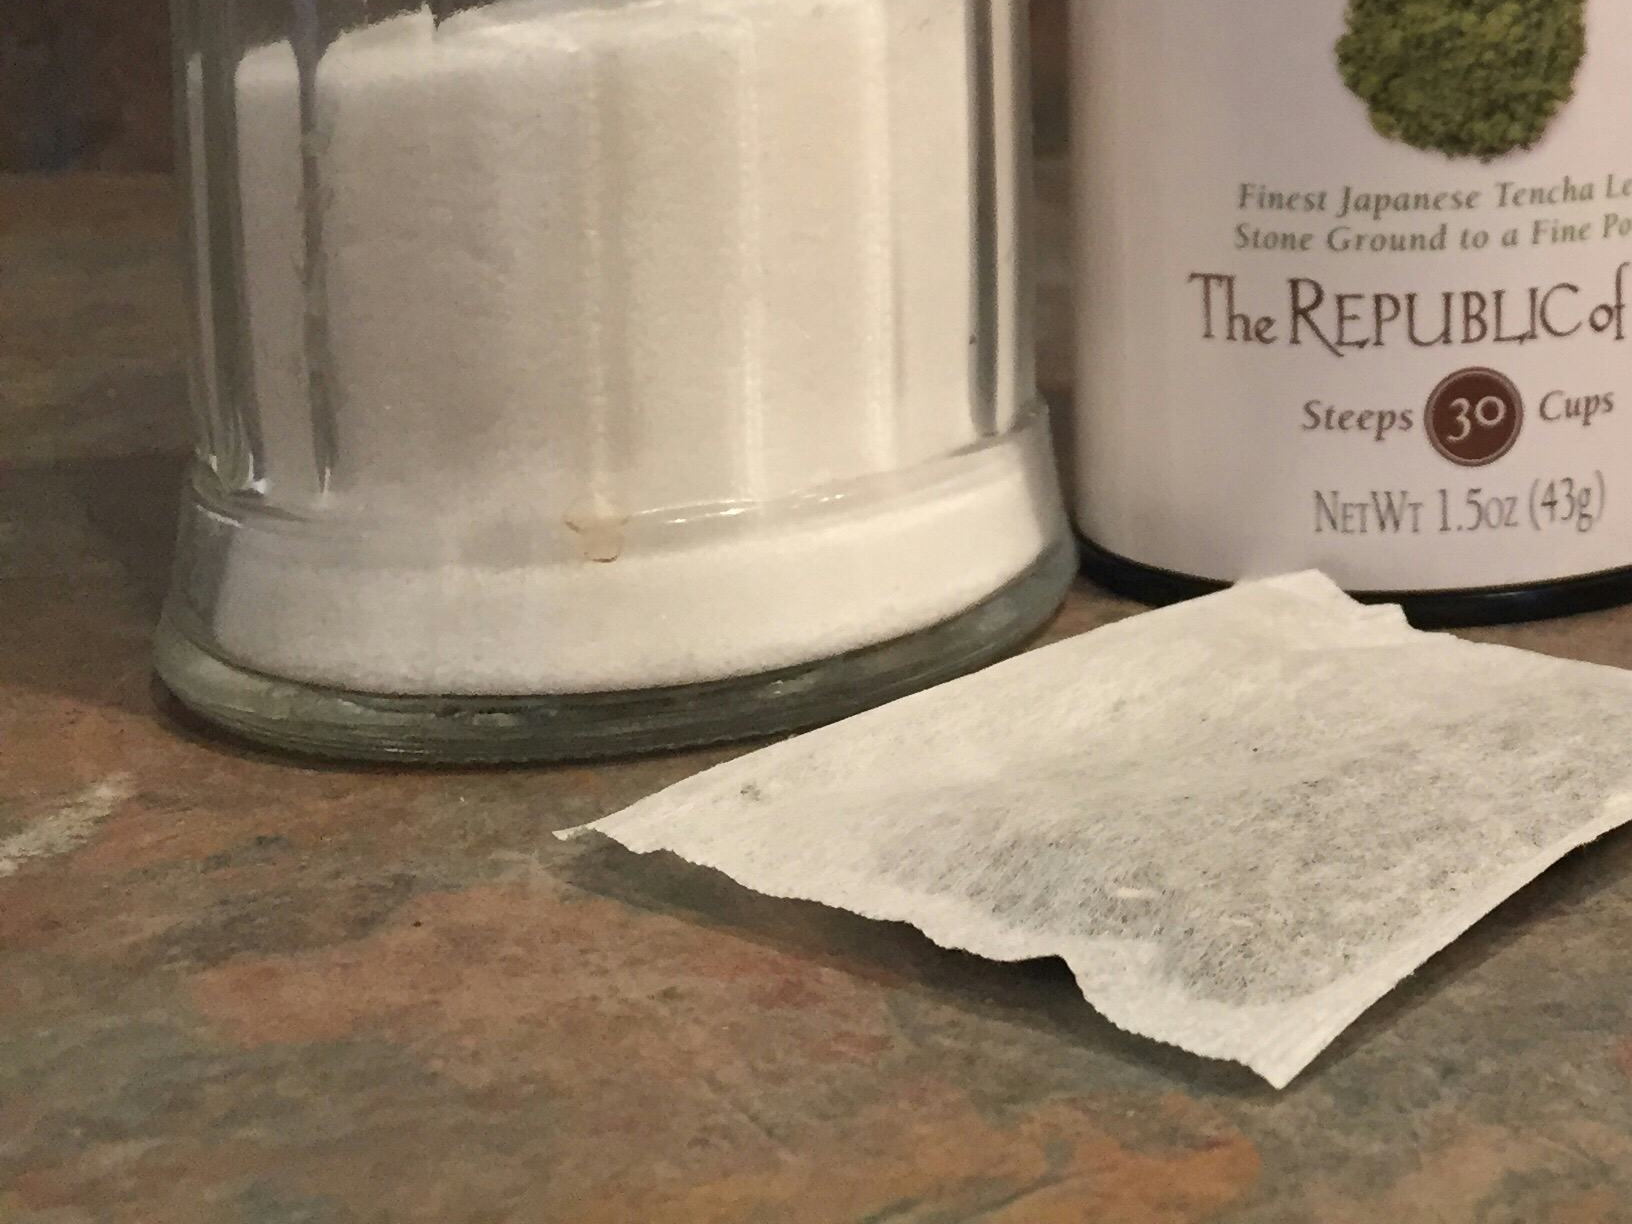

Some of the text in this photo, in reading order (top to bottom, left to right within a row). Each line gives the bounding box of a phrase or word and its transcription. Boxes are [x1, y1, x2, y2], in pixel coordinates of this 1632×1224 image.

[1237, 181, 1328, 214] Finest
[1334, 184, 1481, 220] Japanese
[1494, 176, 1594, 210] Tencha
[1234, 223, 1319, 251] Stone
[1325, 224, 1448, 254] Ground
[1459, 227, 1490, 253] to
[1501, 227, 1520, 248] a
[1531, 222, 1592, 245] Fine
[1187, 272, 1278, 345] The
[1286, 276, 1581, 358] REPUBLIC
[1587, 262, 1628, 341] of
[1301, 389, 1616, 443] Steeps 30 Cups
[1528, 471, 1608, 533] (43g)
